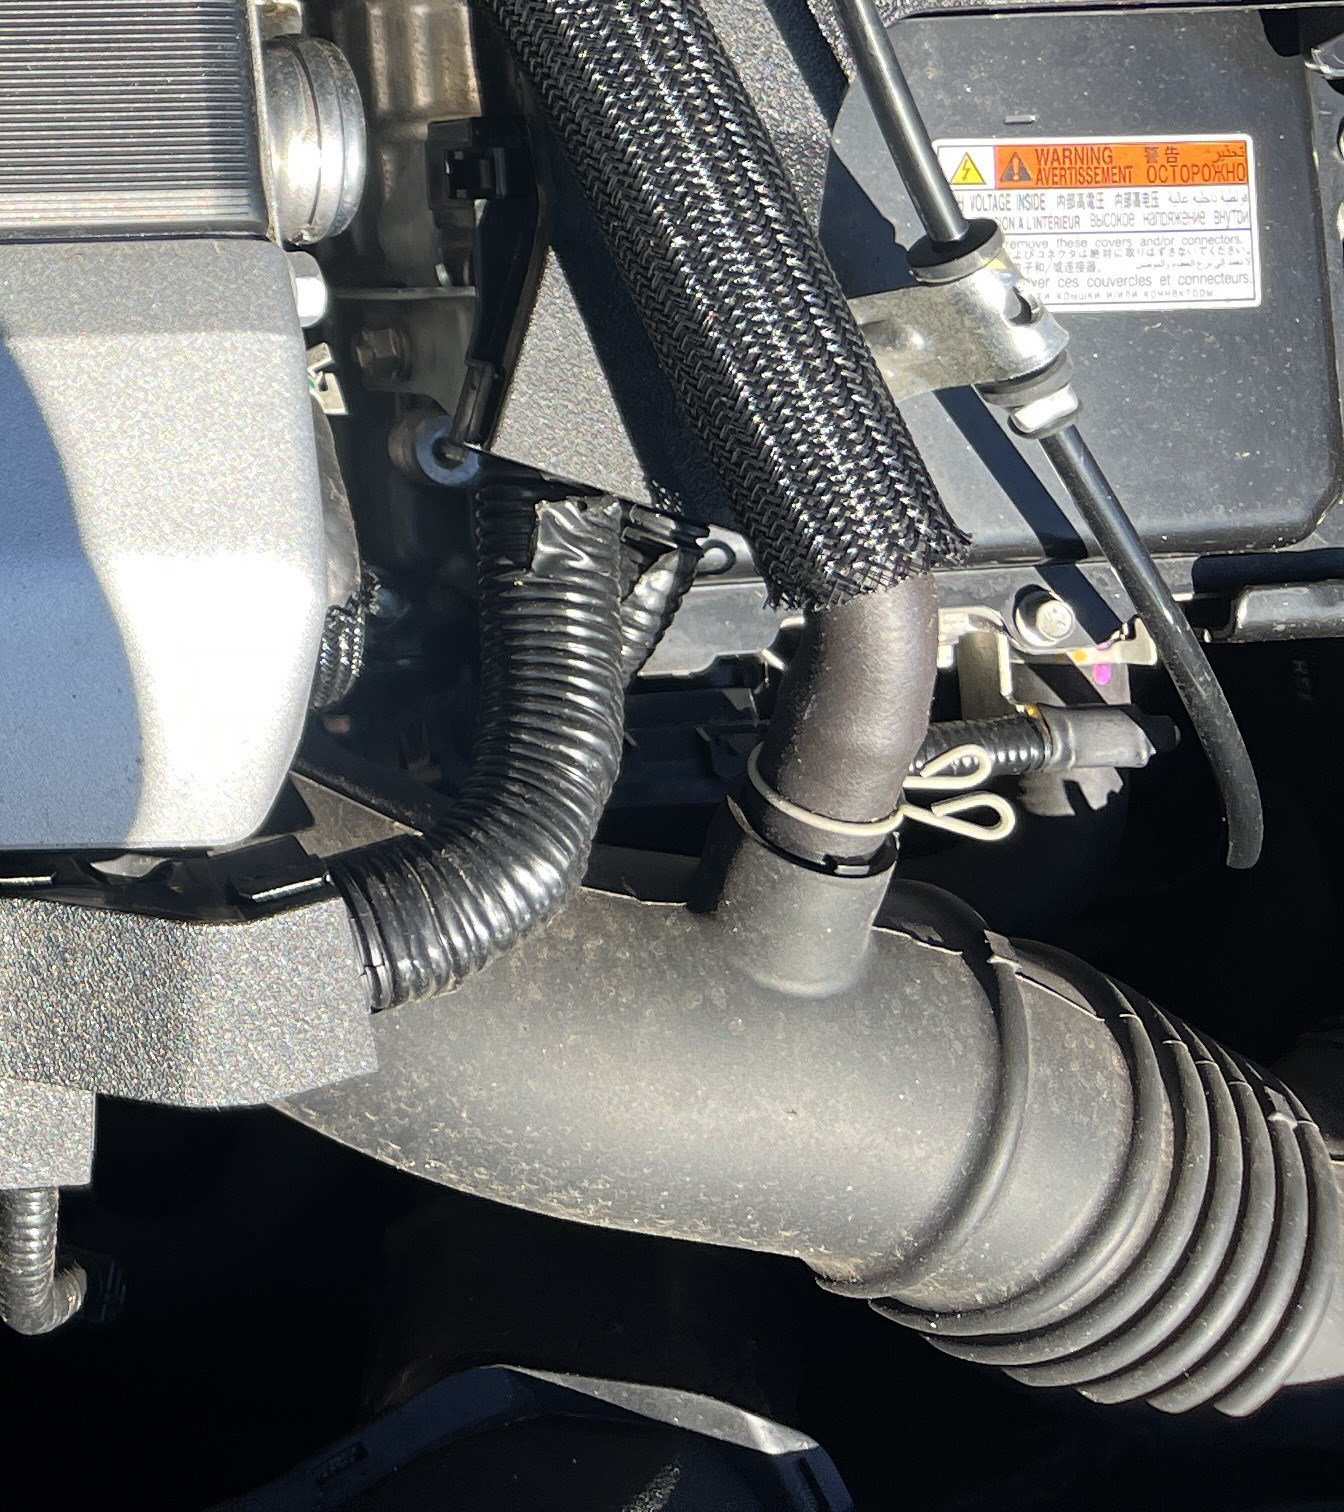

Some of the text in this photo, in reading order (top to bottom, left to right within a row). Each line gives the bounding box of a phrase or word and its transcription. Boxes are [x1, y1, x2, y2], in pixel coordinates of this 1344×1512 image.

[1036, 146, 1113, 166] WARNING
[1035, 165, 1133, 186] AVERTISSEMENT
[970, 193, 1012, 212] VOLTAGE
[1016, 193, 1046, 211] INSIDE
[1056, 238, 1088, 249] these
[1095, 237, 1132, 249] covers
[1140, 236, 1174, 248] and/or
[1057, 276, 1080, 288] ces
[1087, 274, 1152, 288] couvercles
[1159, 273, 1171, 286] et
